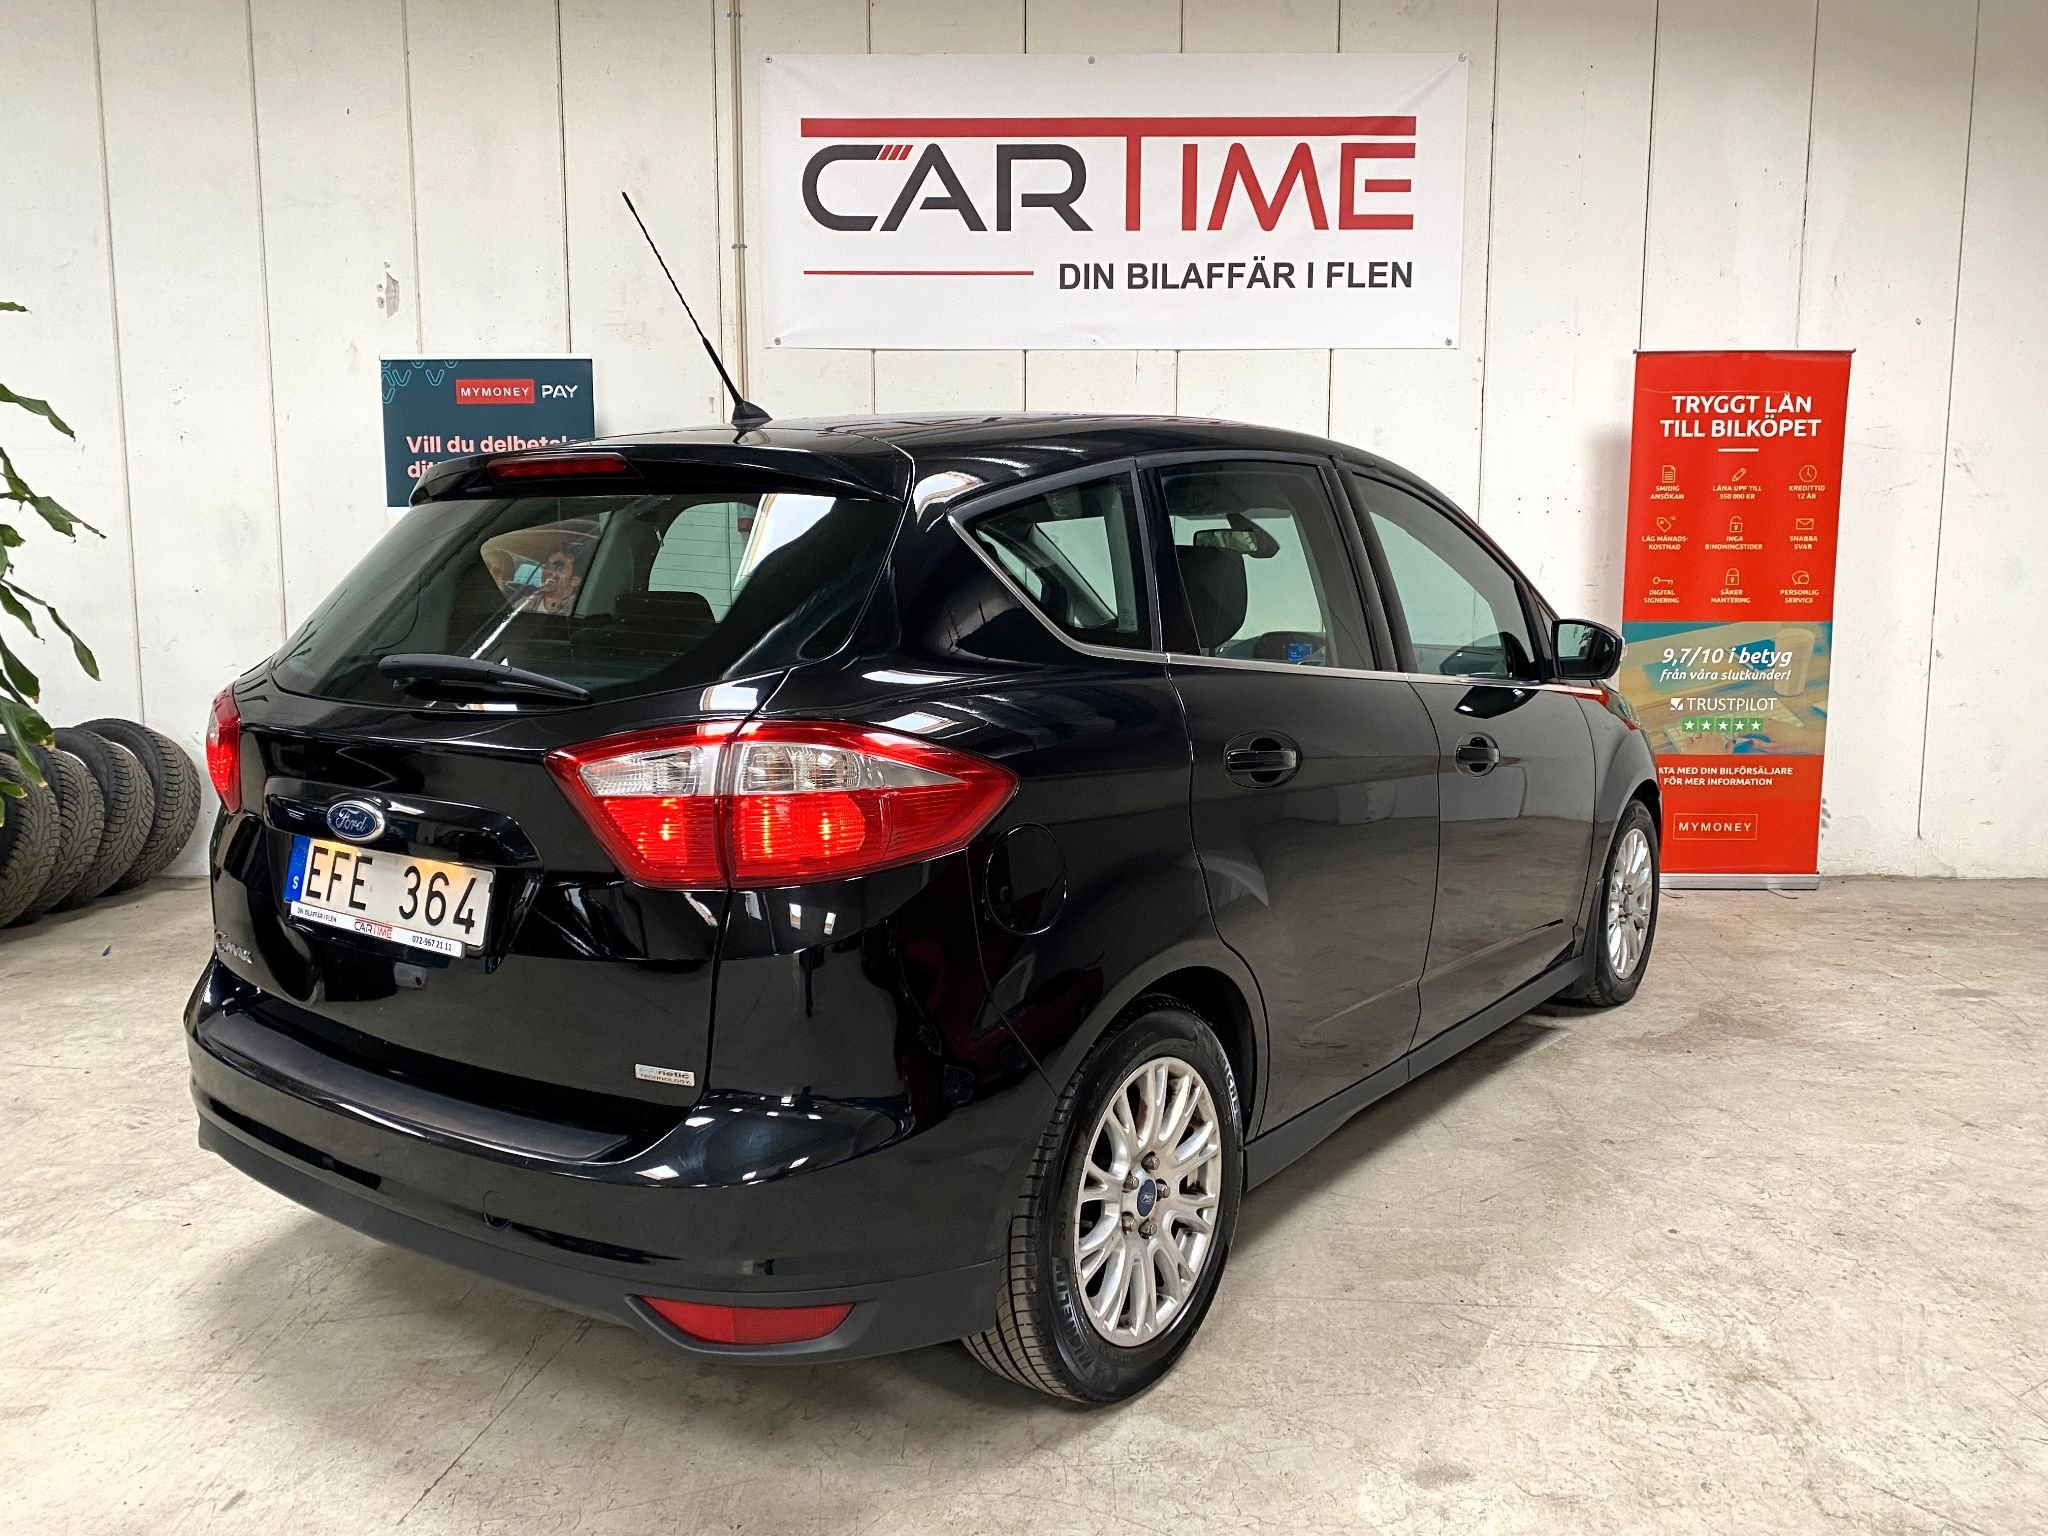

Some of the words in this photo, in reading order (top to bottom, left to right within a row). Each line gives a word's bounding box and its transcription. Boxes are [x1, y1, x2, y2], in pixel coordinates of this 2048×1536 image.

[801, 116, 1417, 232] CARTIME
[1058, 263, 1114, 290] DIN
[1127, 255, 1296, 289] BILAFFÄR
[1308, 262, 1314, 288] I
[1327, 261, 1413, 288] FLEN
[460, 387, 530, 397] MYMONEY
[541, 384, 578, 399] PAY
[1672, 395, 1760, 414] TRYGGT
[1765, 391, 1812, 414] LÅN
[1660, 419, 1706, 437] TILL
[1711, 414, 1822, 437] BILKÖPET
[406, 435, 441, 454] Vill
[447, 435, 474, 453] du
[480, 435, 576, 453] delbet
[1712, 484, 1732, 492] LÅNA
[1650, 492, 1685, 500] ANSÖKAN
[1806, 492, 1817, 500] ÅR
[1641, 534, 1656, 542] LÅG
[1720, 588, 1743, 596] SÄKER
[1662, 646, 1724, 667] 9,7/10
[1728, 647, 1736, 664] i
[1739, 647, 1793, 667] betyg
[1659, 668, 1686, 683] från
[1690, 668, 1719, 680] våra
[1720, 669, 1792, 681] slutkunder!
[1687, 697, 1778, 711] TRUSTPILOT
[1658, 766, 1674, 775] ATA
[1677, 767, 1698, 775] MED
[1700, 767, 1717, 775] DIN
[1720, 765, 1793, 775] BILFÖRSÄLJARE
[1664, 776, 1682, 785] FÖR
[1685, 777, 1705, 785] MER
[1707, 777, 1773, 786] INFORMATION
[335, 807, 367, 832] Ford
[1678, 821, 1752, 832] MYMONEY
[292, 876, 299, 890] S
[305, 846, 373, 911] EFE
[399, 865, 477, 935] 364
[354, 917, 393, 940] CARTIME
[411, 935, 435, 948] 072-967
[435, 939, 443, 949] 21
[445, 941, 452, 951] 11
